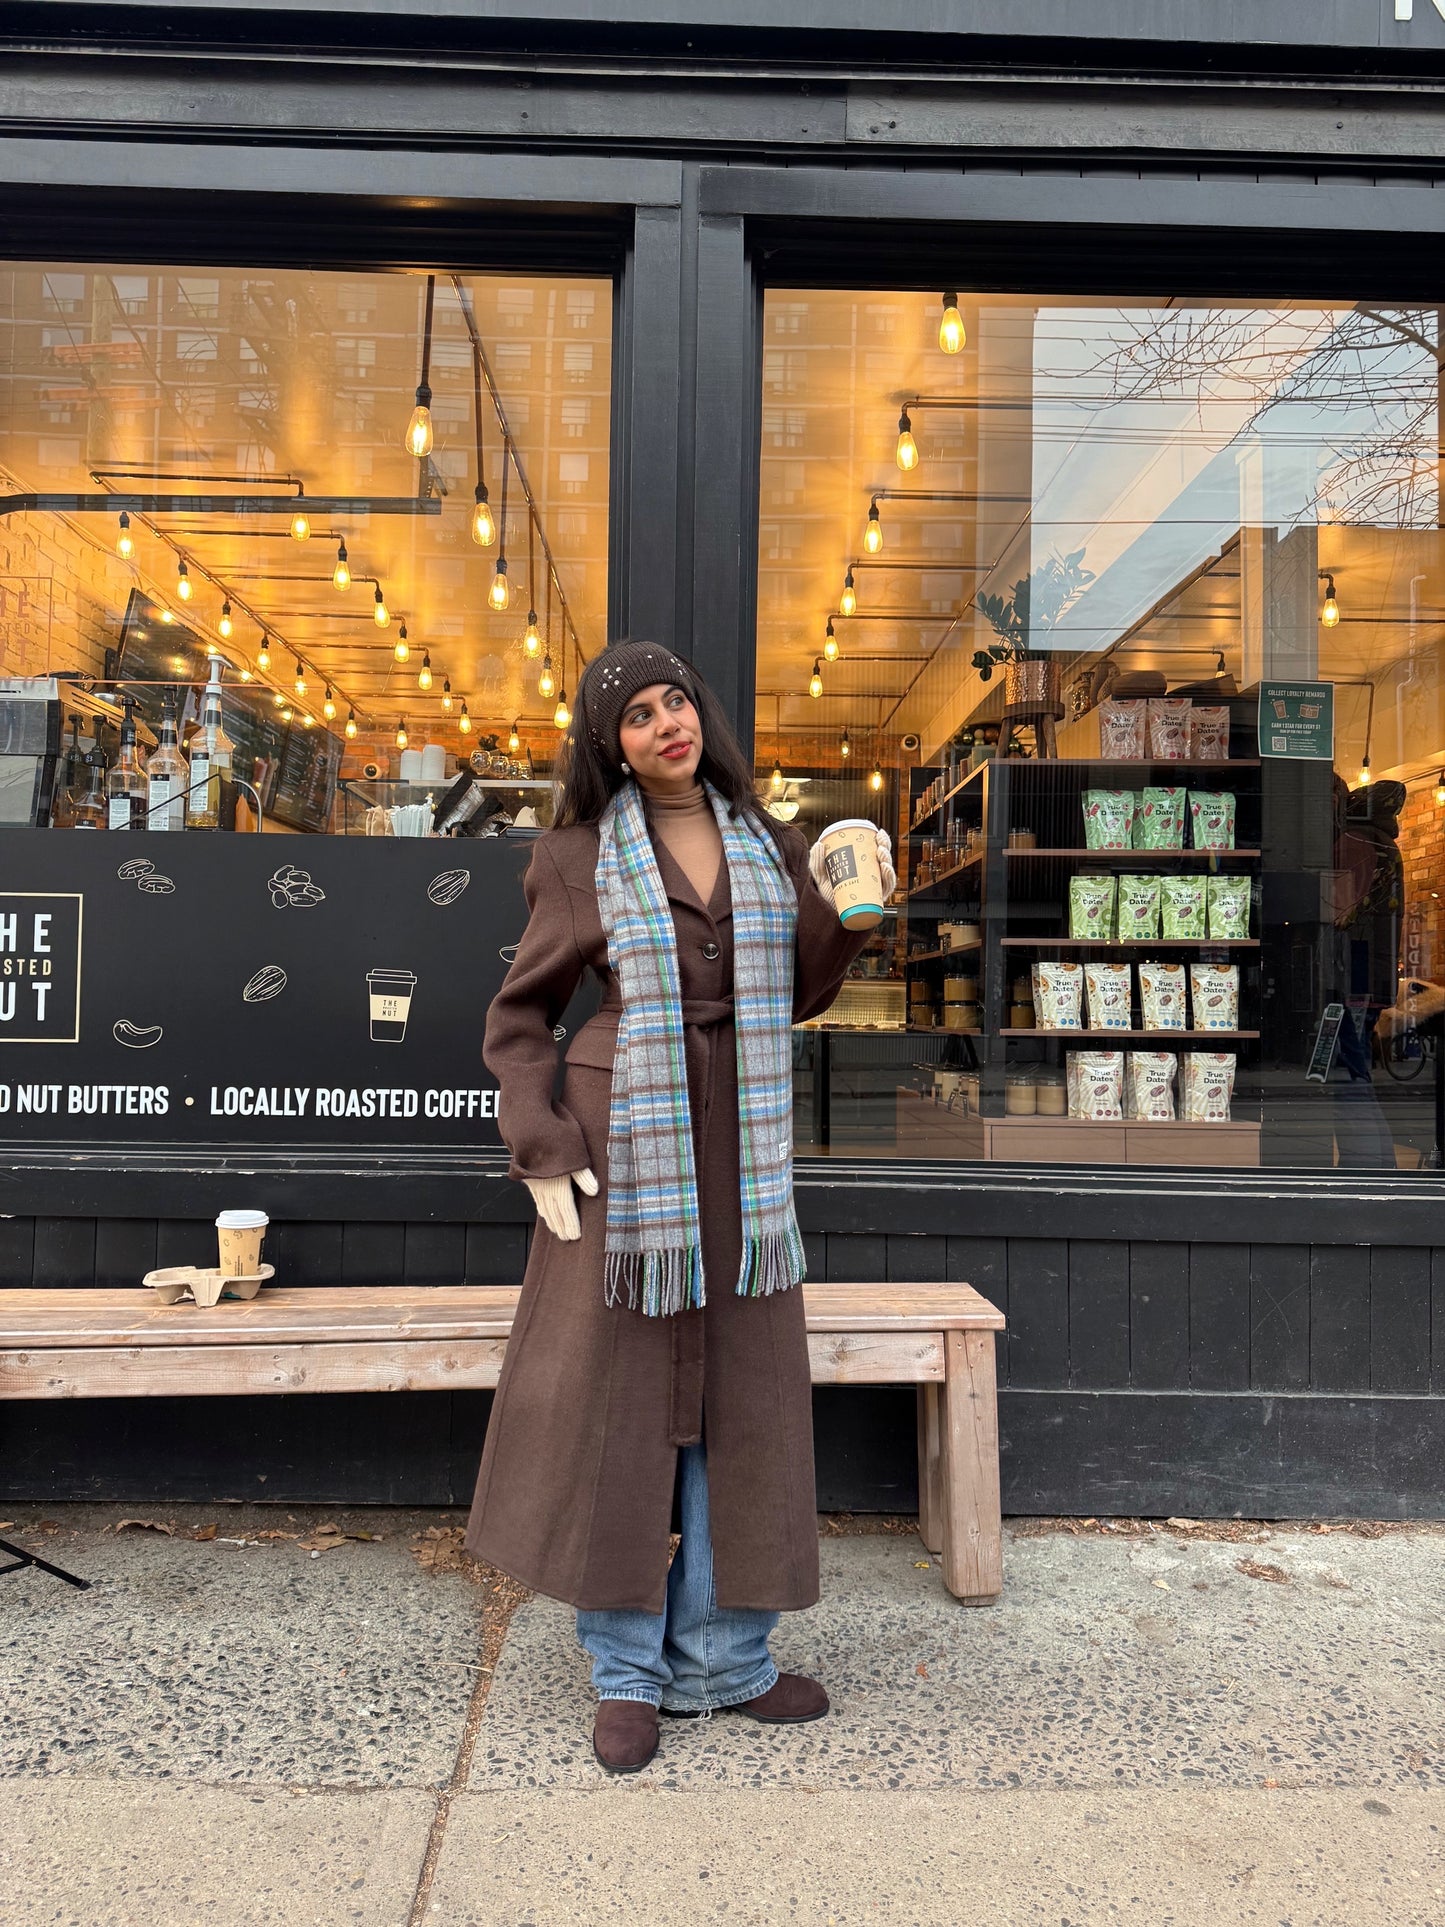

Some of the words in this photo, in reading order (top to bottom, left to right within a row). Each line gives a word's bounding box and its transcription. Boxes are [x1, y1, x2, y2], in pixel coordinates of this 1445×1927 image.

[828, 851, 847, 867] THE
[831, 865, 849, 883] NUT
[3, 958, 52, 976] STED
[383, 999, 398, 1007] THE
[16, 1084, 63, 1114] NUT
[67, 1085, 170, 1115] BUTTERS
[210, 1086, 310, 1117] LOCALLY
[315, 1088, 418, 1118] ROASTED
